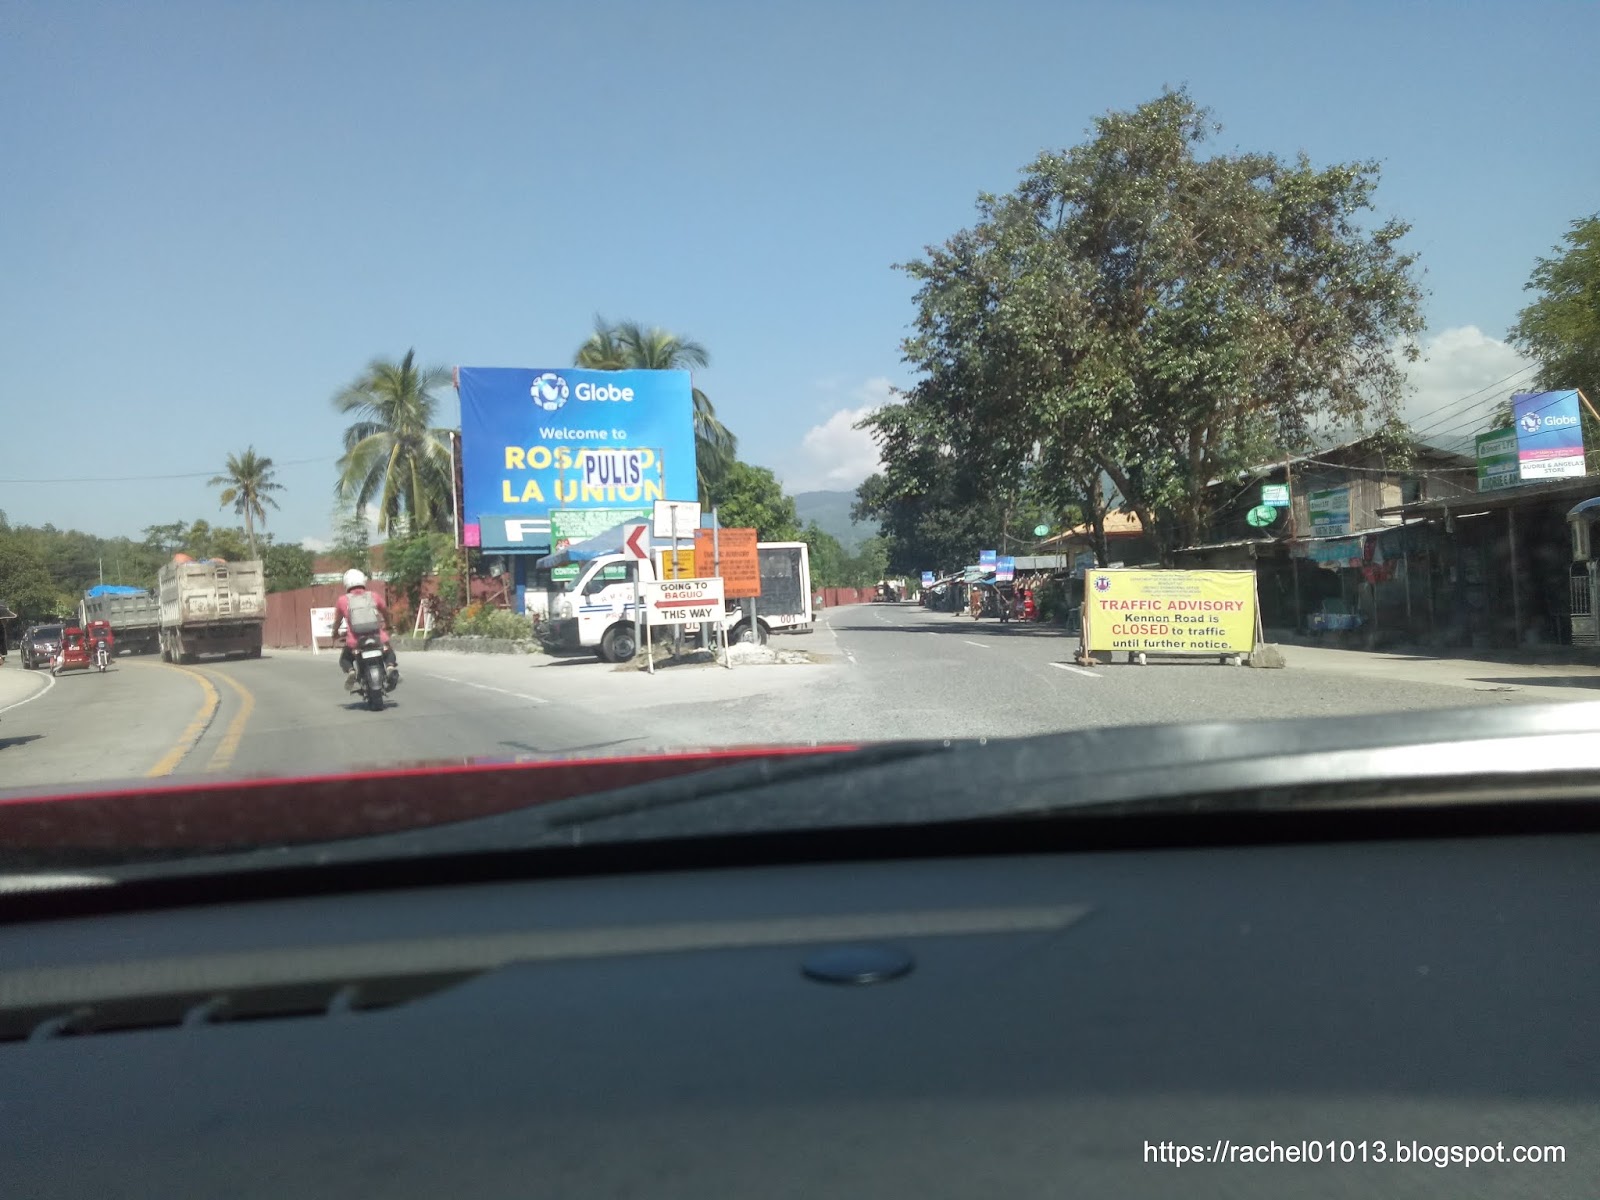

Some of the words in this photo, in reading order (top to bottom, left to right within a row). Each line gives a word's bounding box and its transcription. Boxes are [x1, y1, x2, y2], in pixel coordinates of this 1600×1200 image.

[575, 382, 635, 402] Globe
[1544, 415, 1577, 426] Globe
[539, 426, 608, 441] Welcome
[612, 428, 627, 441] to
[585, 454, 641, 485] PULIS
[502, 480, 545, 504] LA
[554, 479, 664, 503] UNION
[660, 582, 691, 592] GOING
[694, 582, 708, 590] TO
[664, 591, 704, 599] BAGUIO
[1100, 600, 1162, 611] TRAFFIC
[1167, 600, 1244, 611] ADVISORY
[661, 610, 687, 620] THIS
[689, 608, 713, 619] WAY
[1124, 614, 1170, 623] Kennon
[1174, 614, 1205, 623] Road
[1209, 614, 1220, 623] is
[1112, 624, 1169, 635] CLOSED
[1172, 627, 1184, 636] to
[1188, 626, 1226, 636] traffic
[1112, 639, 1140, 648] until
[1143, 639, 1186, 649] further
[1190, 640, 1233, 649] notice.
